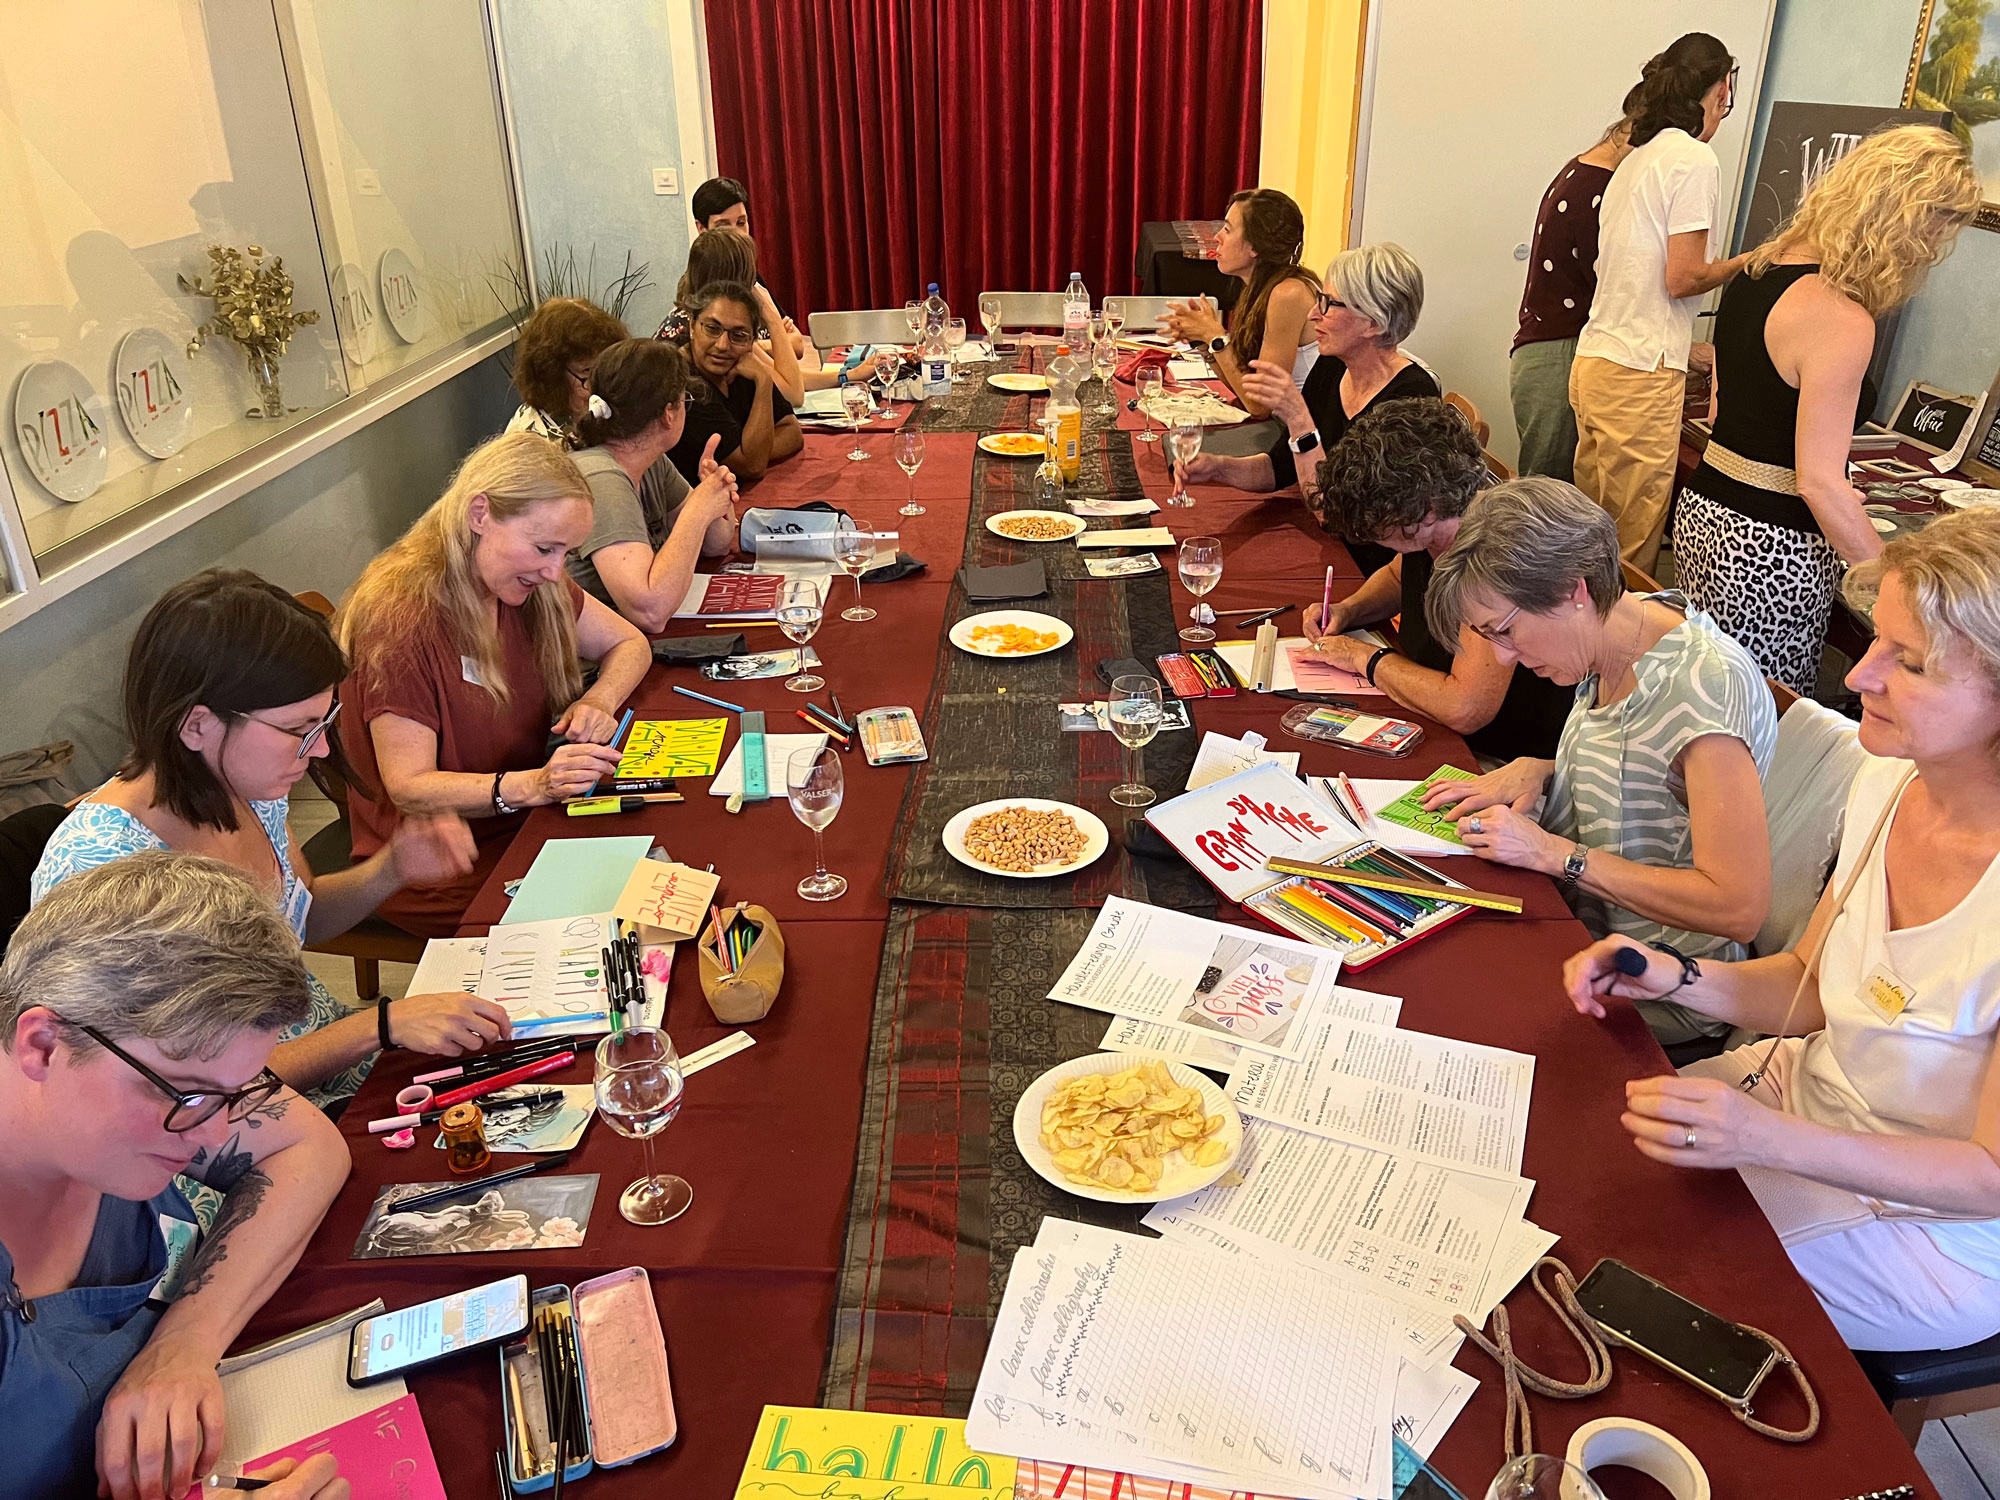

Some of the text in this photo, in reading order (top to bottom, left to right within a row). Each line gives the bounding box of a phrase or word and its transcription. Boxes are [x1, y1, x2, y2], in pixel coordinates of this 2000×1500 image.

[119, 356, 183, 430] PIZZA
[1913, 404, 1944, 433] Office
[21, 391, 101, 476] PIZZA
[800, 788, 834, 800] VALSER
[1195, 817, 1268, 872] CARAN
[1099, 909, 1125, 940] Guide
[1222, 974, 1260, 996] VIEL
[643, 996, 655, 1021] Helsana
[1258, 1070, 1275, 1097] BRAUCHST
[1254, 1096, 1265, 1109] WAS
[1030, 1261, 1101, 1397] faux calligraphy
